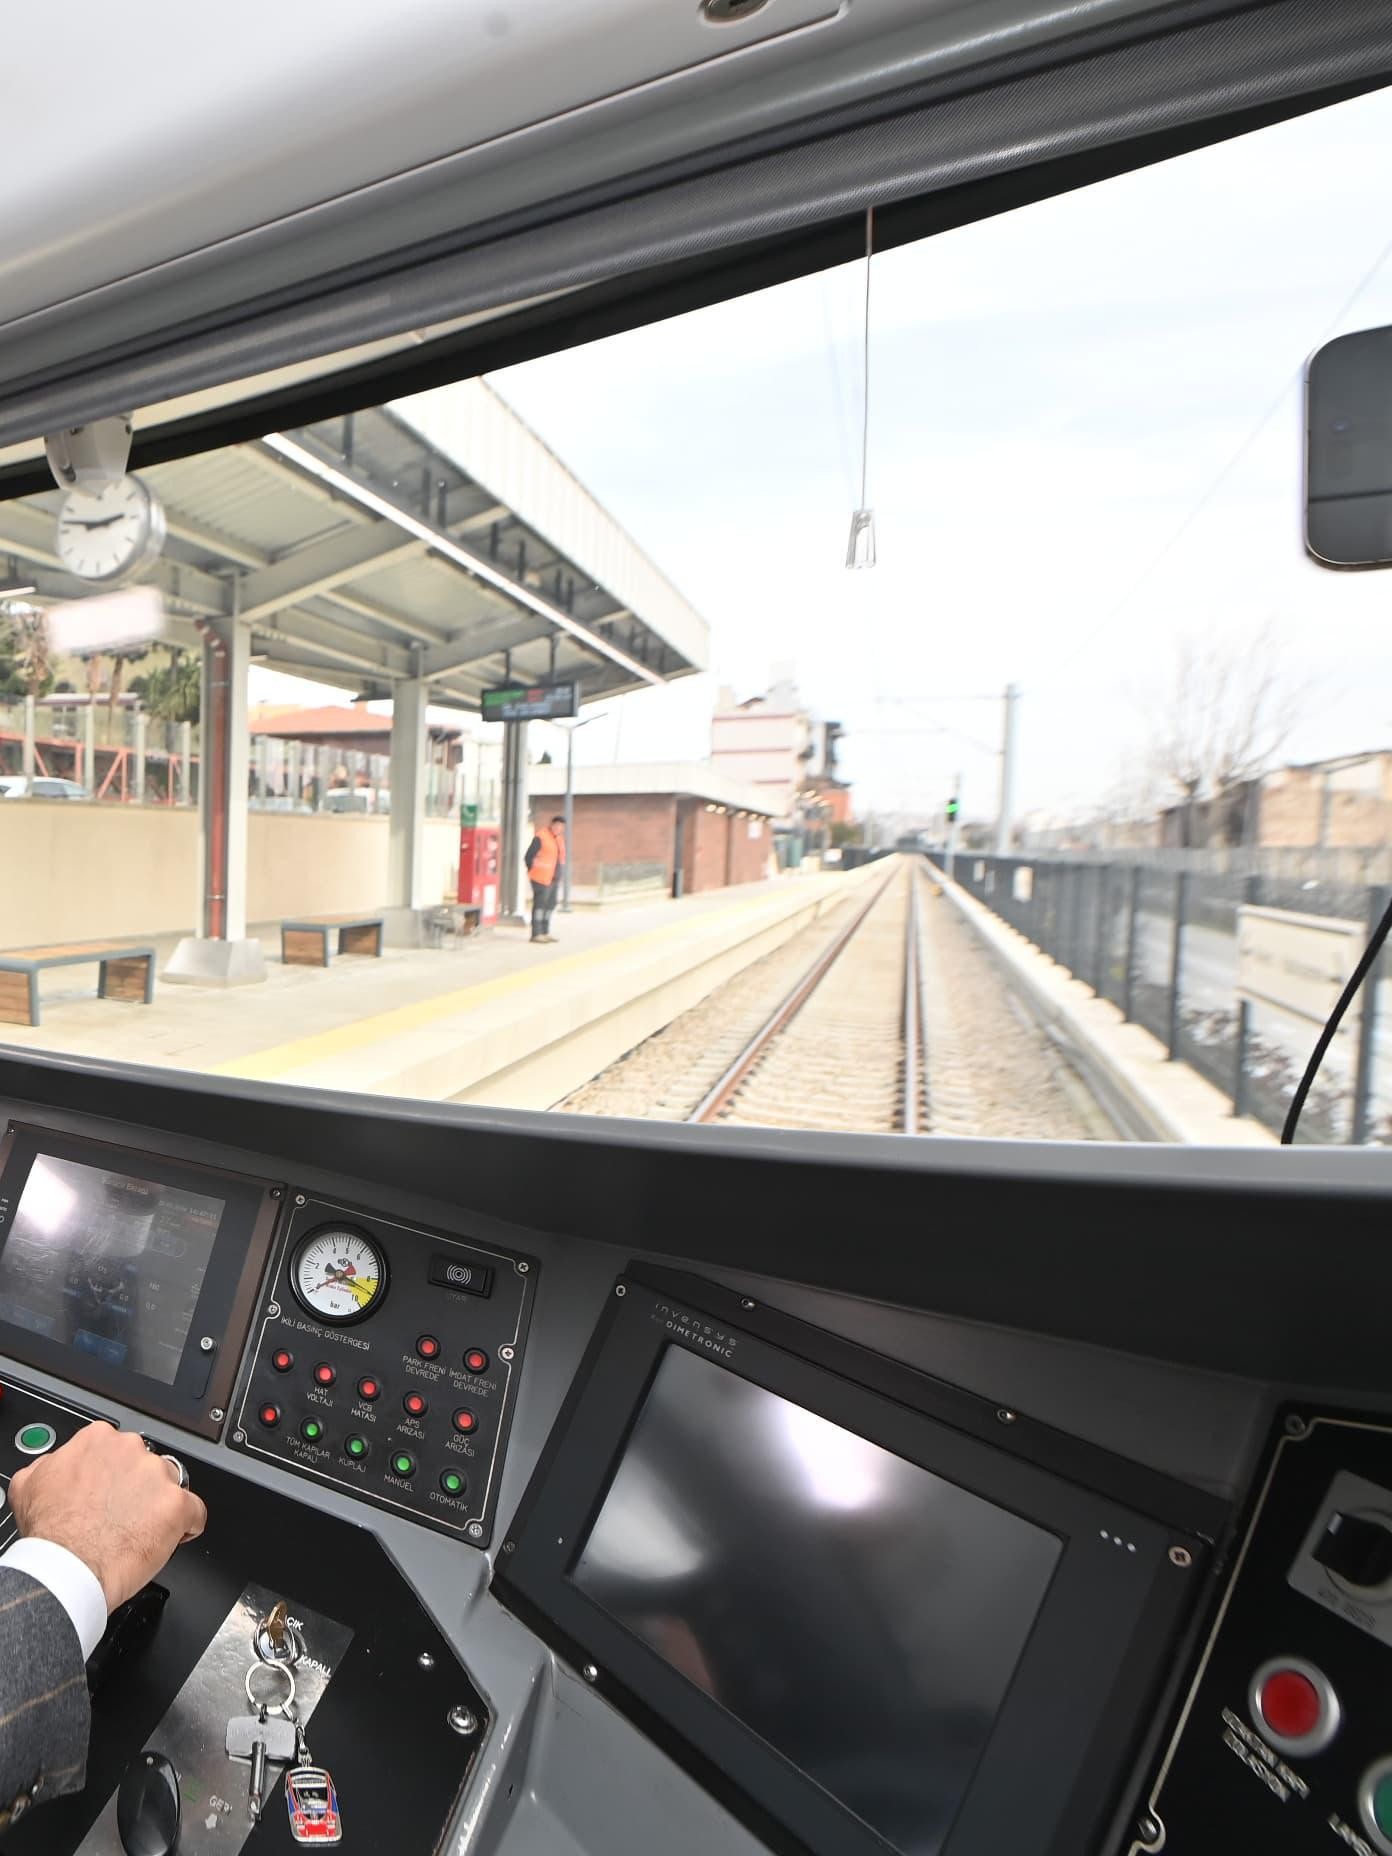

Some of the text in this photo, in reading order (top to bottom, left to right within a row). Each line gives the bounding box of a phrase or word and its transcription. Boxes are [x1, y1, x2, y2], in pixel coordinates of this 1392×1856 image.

[666, 1321, 733, 1358] DIMETRONIC
[402, 1356, 423, 1367] PARK
[405, 1365, 440, 1382] DEVREDE
[314, 1386, 329, 1396] HAT
[453, 1380, 489, 1398] DEVREDE
[339, 1457, 367, 1473] KUPLAJ
[383, 1474, 414, 1493] MANUEL
